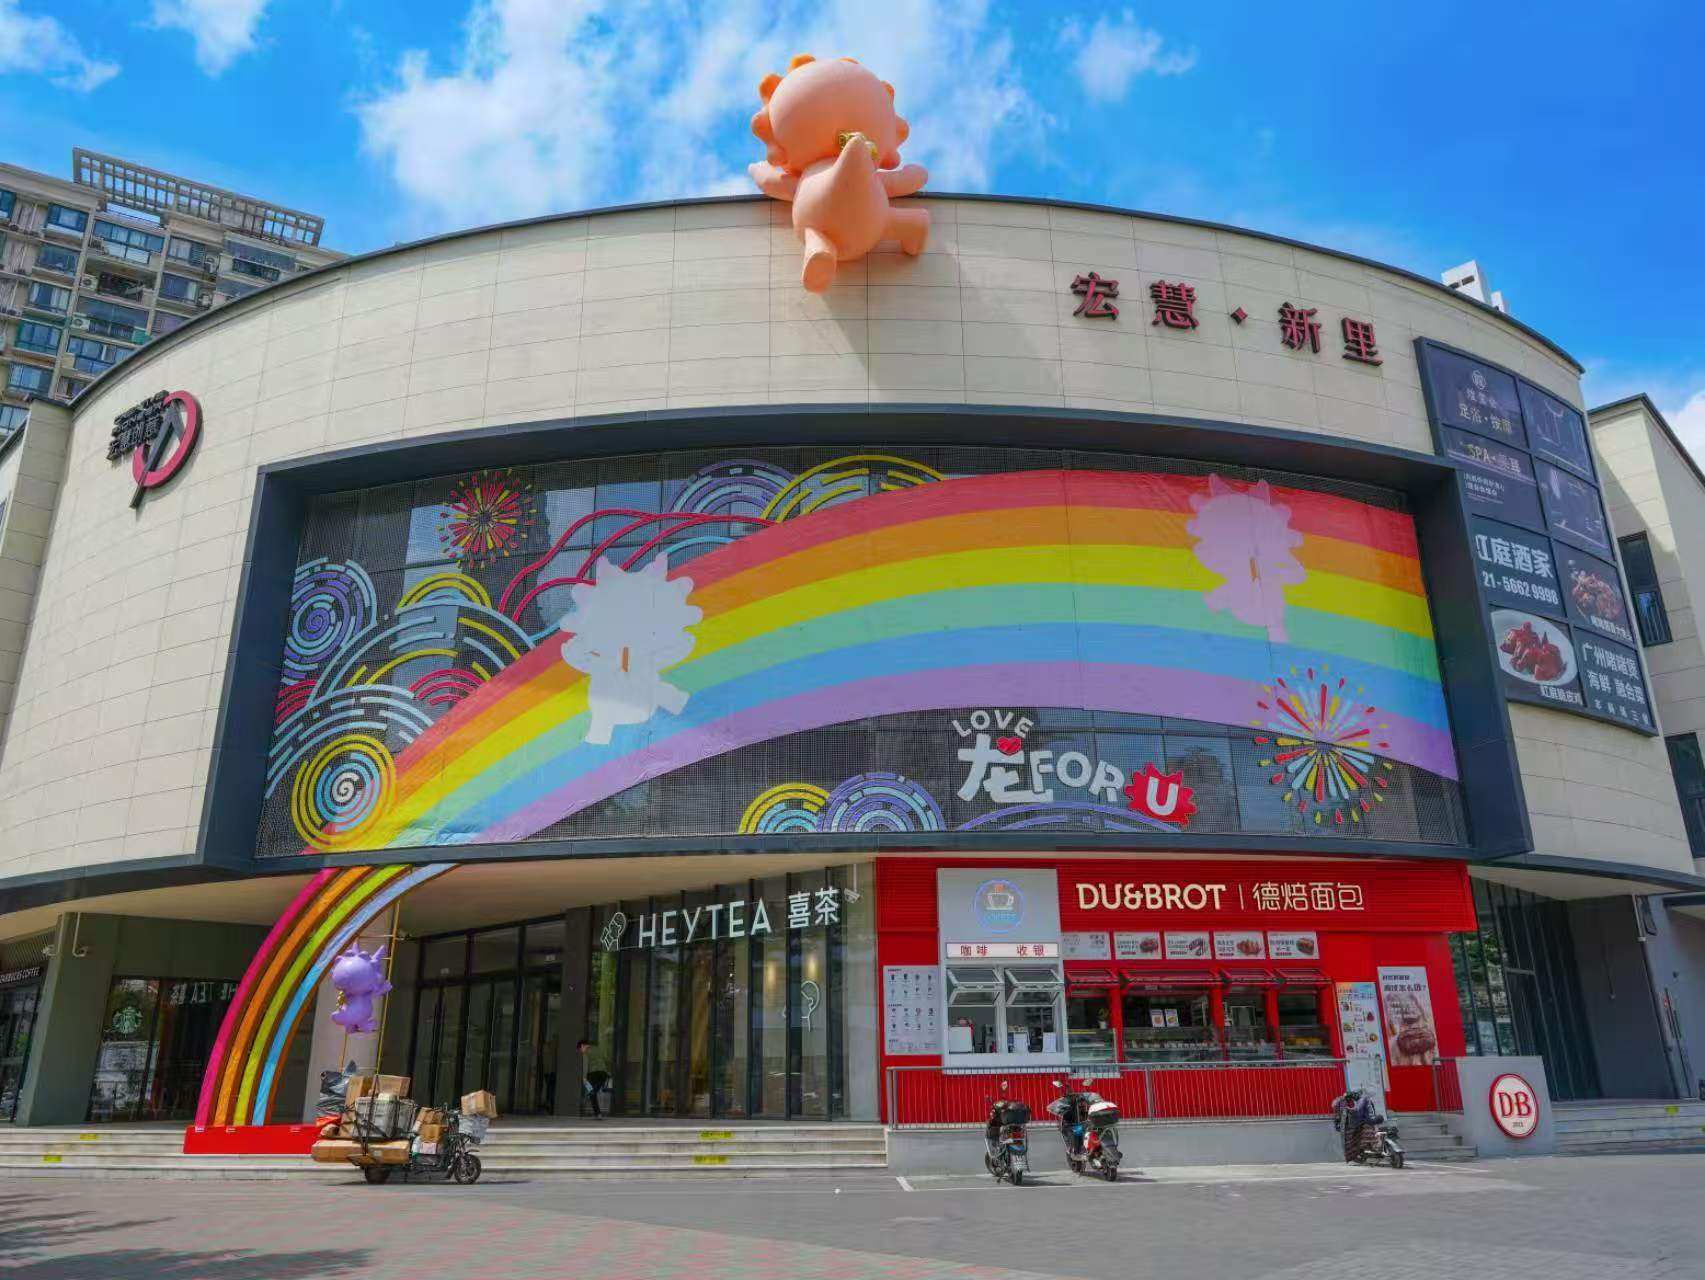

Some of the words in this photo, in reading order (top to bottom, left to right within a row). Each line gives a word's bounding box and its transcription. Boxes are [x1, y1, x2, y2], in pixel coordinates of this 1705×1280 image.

[951, 709, 1034, 738] LOVE
[1030, 750, 1125, 802] FOR
[1146, 776, 1179, 815] U
[1075, 882, 1227, 910] DU&BROT
[1252, 881, 1365, 911] 德焙面包
[638, 898, 772, 948] HEYTEA
[788, 886, 841, 929] 喜茶
[960, 944, 988, 957] 咖啡
[1016, 944, 1045, 957] 收银
[1497, 1091, 1531, 1117] DB
